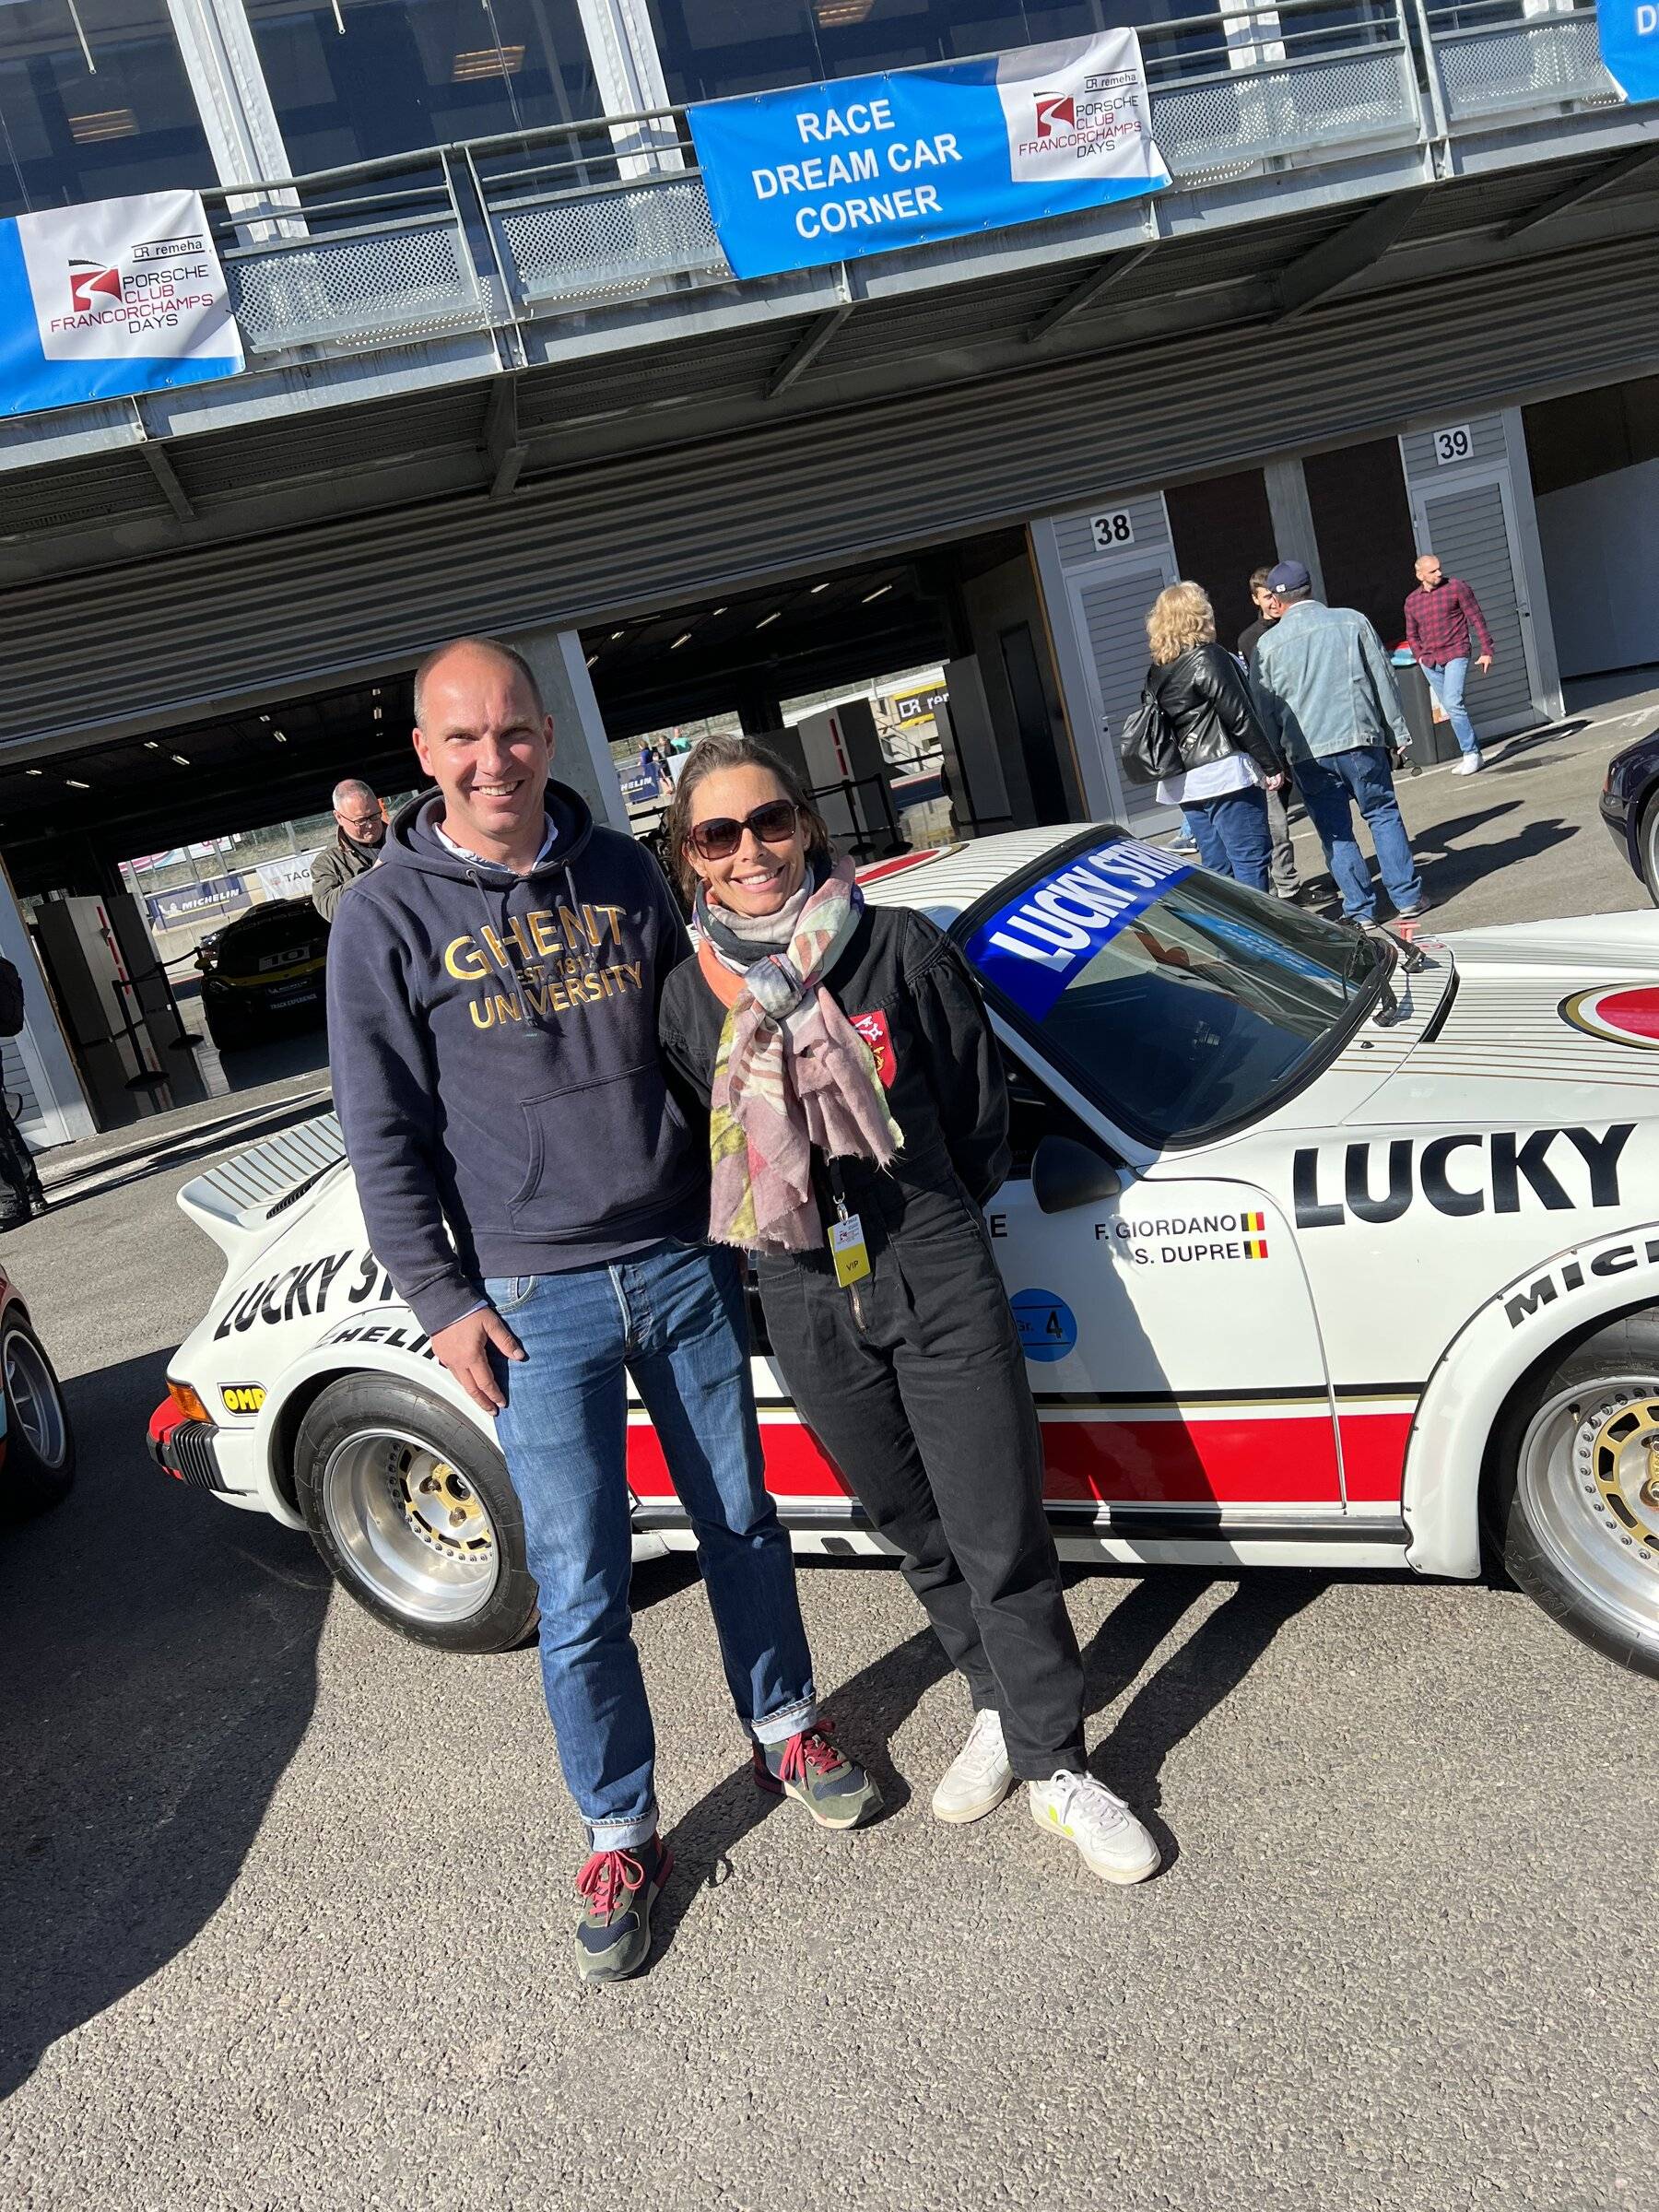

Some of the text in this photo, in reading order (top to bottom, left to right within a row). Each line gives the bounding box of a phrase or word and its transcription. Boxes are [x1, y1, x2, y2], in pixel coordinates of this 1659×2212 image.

[1100, 73, 1136, 88] remeha
[1076, 95, 1139, 117] PORSCHE
[796, 99, 895, 144] RACE
[1076, 112, 1114, 130] CLUB
[1018, 121, 1142, 156] FRANCORCHAMPS
[1077, 139, 1115, 159] DAYS
[751, 133, 963, 200] DREAM CAR
[795, 184, 944, 240] CORNER
[156, 240, 203, 255] remeha
[123, 265, 209, 289] PORSCHE
[124, 284, 174, 304] CLUB
[51, 293, 214, 333] FRANCORCHAMPS
[128, 313, 178, 335] DAYS
[1438, 430, 1468, 460] 39
[1094, 514, 1131, 546] 38
[284, 868, 310, 883] TAG
[182, 888, 240, 911] MICHELIN
[988, 865, 1138, 972] LUCKY
[444, 904, 627, 981] GHENT
[1292, 1123, 1639, 1230] LUCKY
[1095, 1214, 1237, 1241] F. GIORDANO
[846, 1259, 859, 1272] VIP
[1135, 1242, 1241, 1265] S. DUPRE
[213, 1249, 355, 1342] LUCKY
[1046, 1311, 1063, 1339] 4
[223, 1388, 266, 1410] OMP
